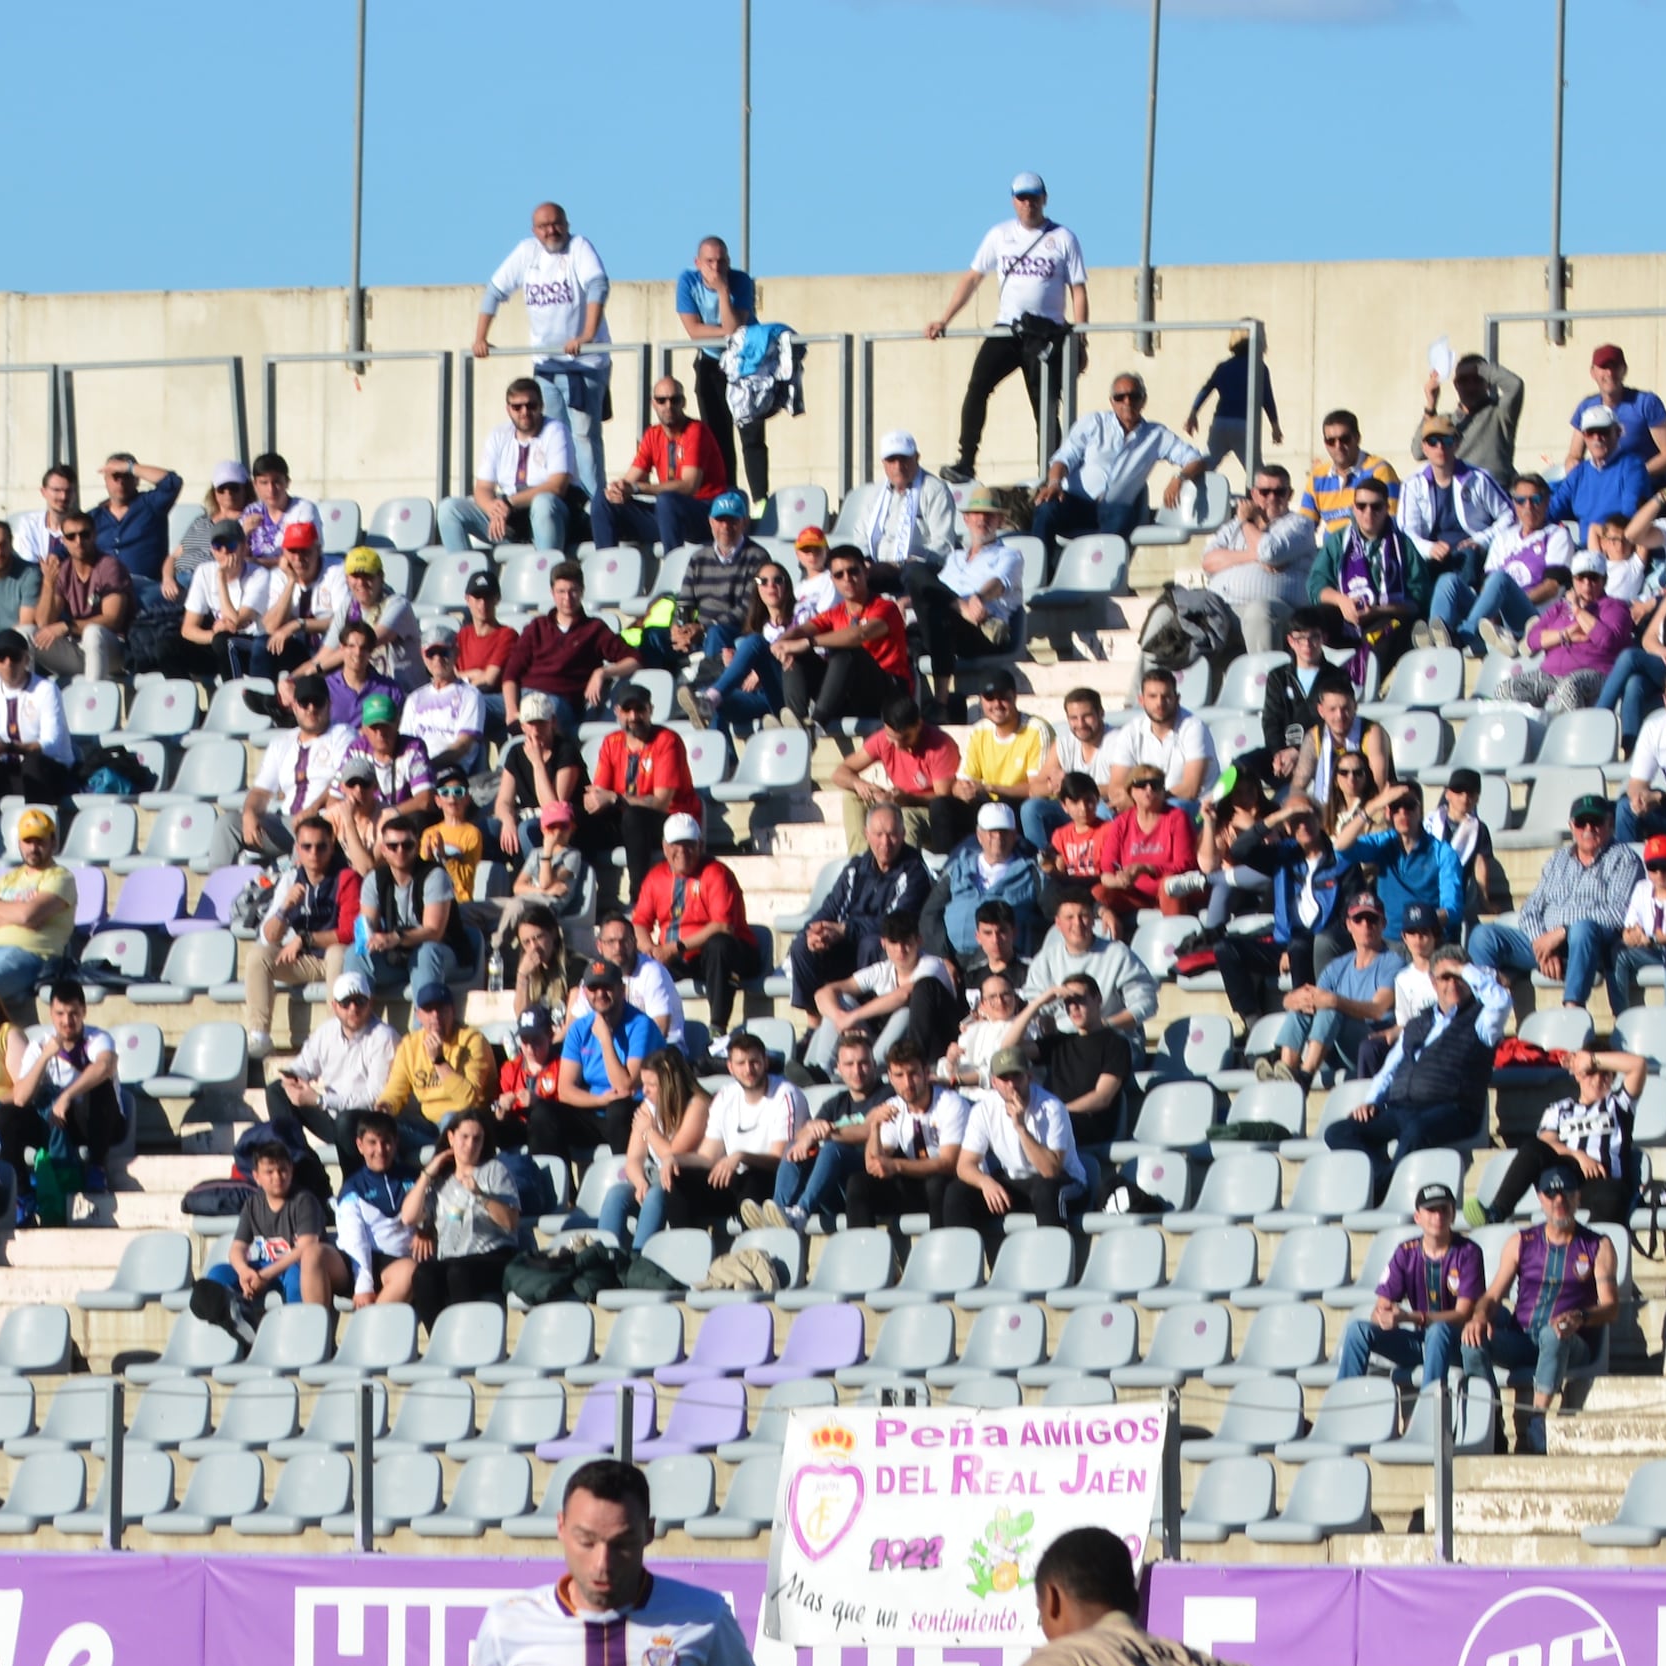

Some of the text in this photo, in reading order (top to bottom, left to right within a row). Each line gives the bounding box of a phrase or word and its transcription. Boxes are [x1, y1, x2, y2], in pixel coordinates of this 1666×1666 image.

[876, 1416, 1160, 1448] Peña AMIGOS
[876, 1466, 938, 1495] DEL
[869, 1535, 946, 1571] 1922
[771, 1573, 823, 1613] Mas
[832, 1600, 866, 1631] que
[876, 1609, 898, 1630] un
